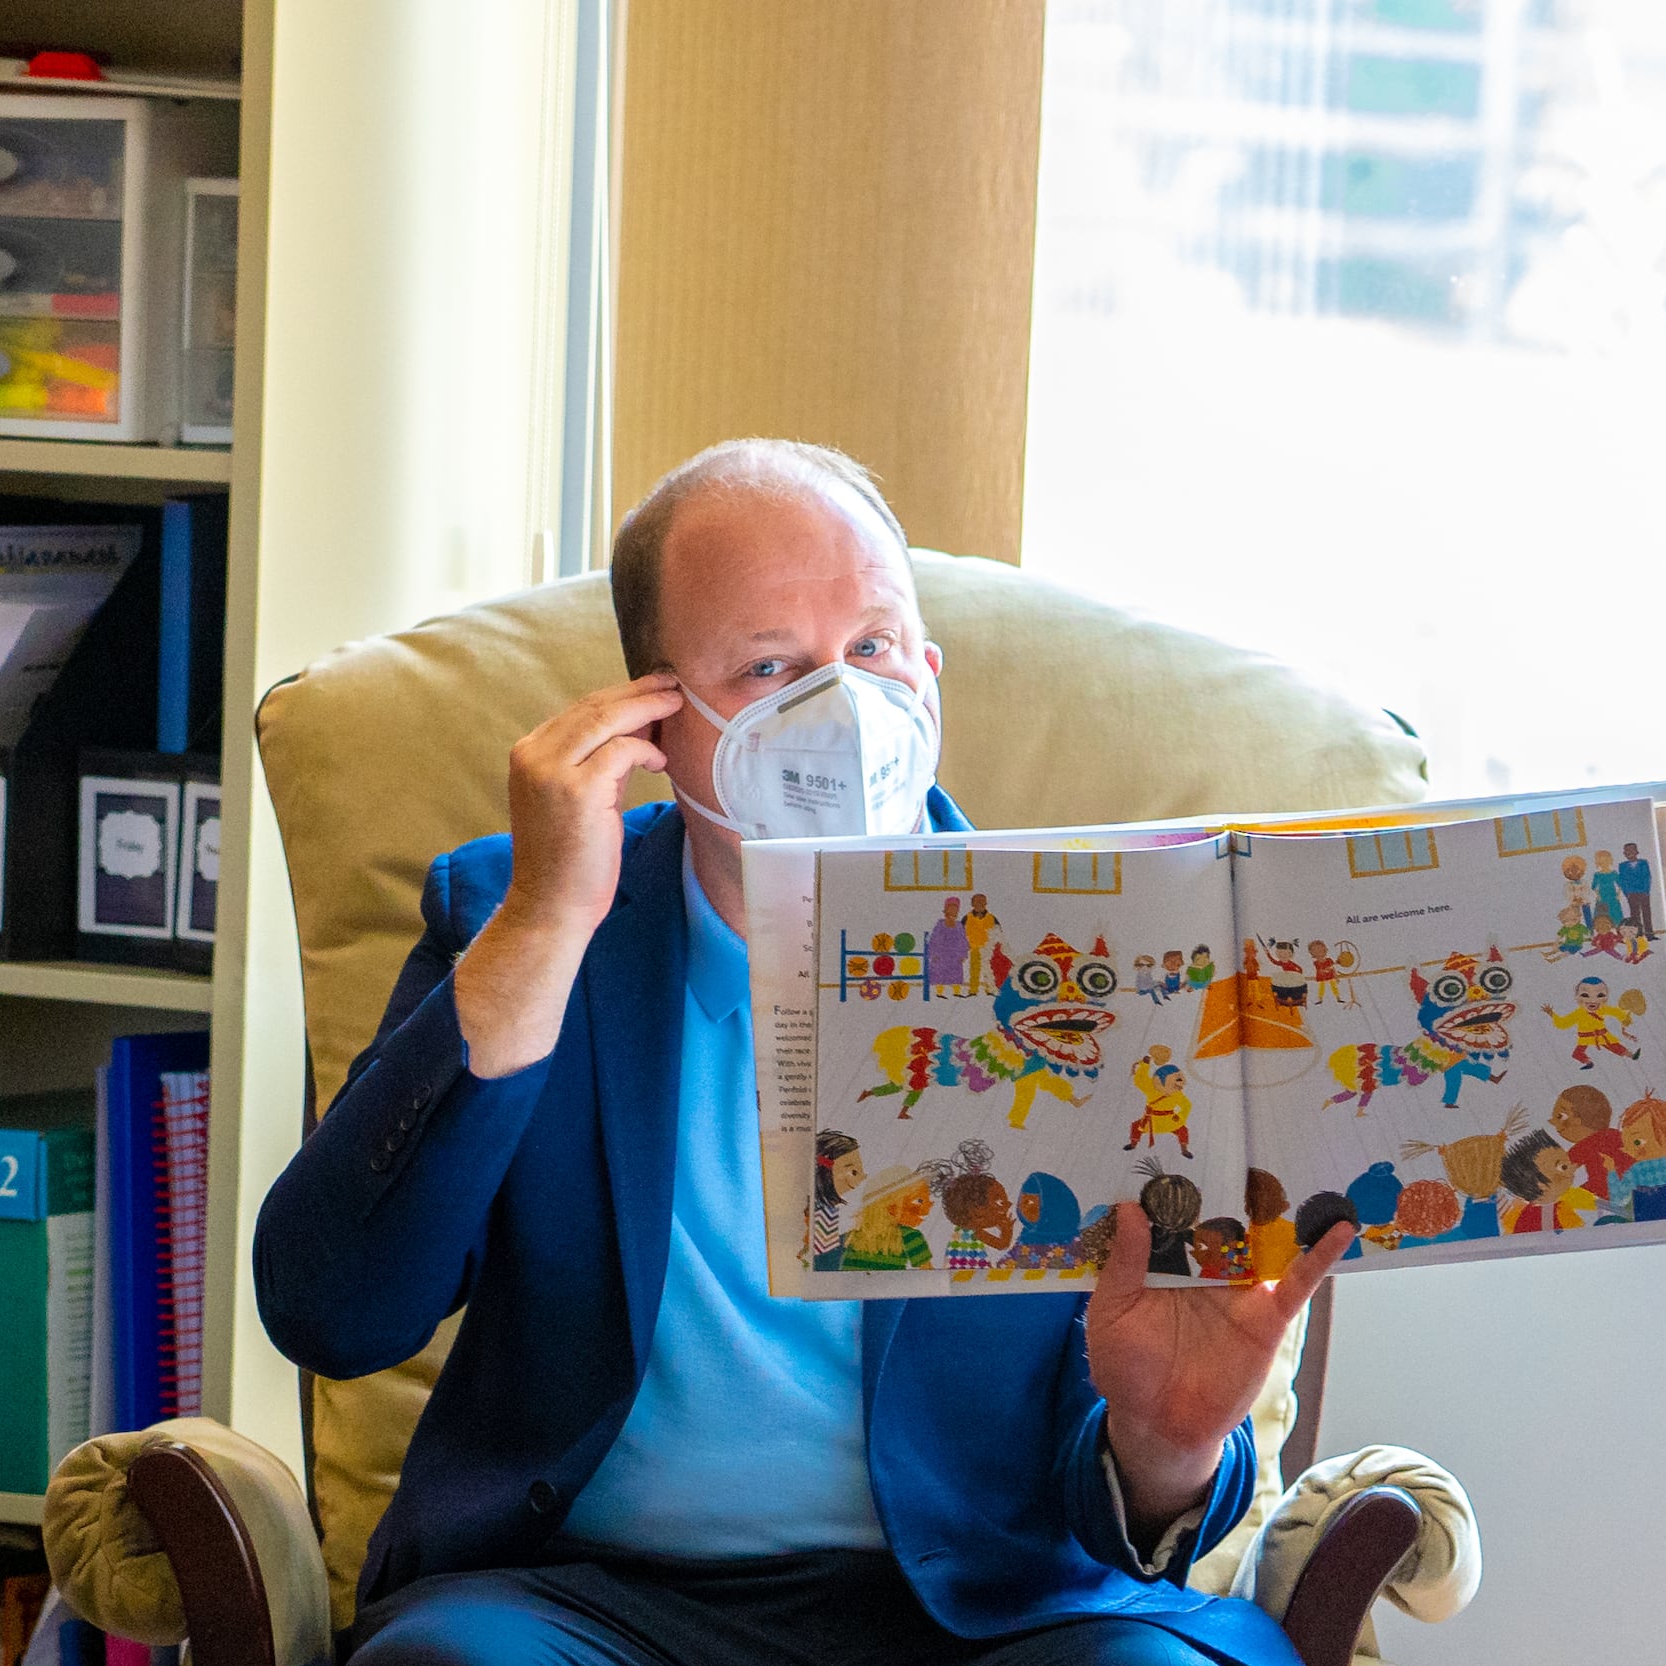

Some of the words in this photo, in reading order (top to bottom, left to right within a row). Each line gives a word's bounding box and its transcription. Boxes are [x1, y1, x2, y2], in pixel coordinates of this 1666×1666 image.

[782, 768, 800, 785] 3M
[1346, 914, 1361, 924] All
[1363, 914, 1378, 924] are
[1381, 907, 1425, 921] welcome
[1427, 903, 1453, 914] here.
